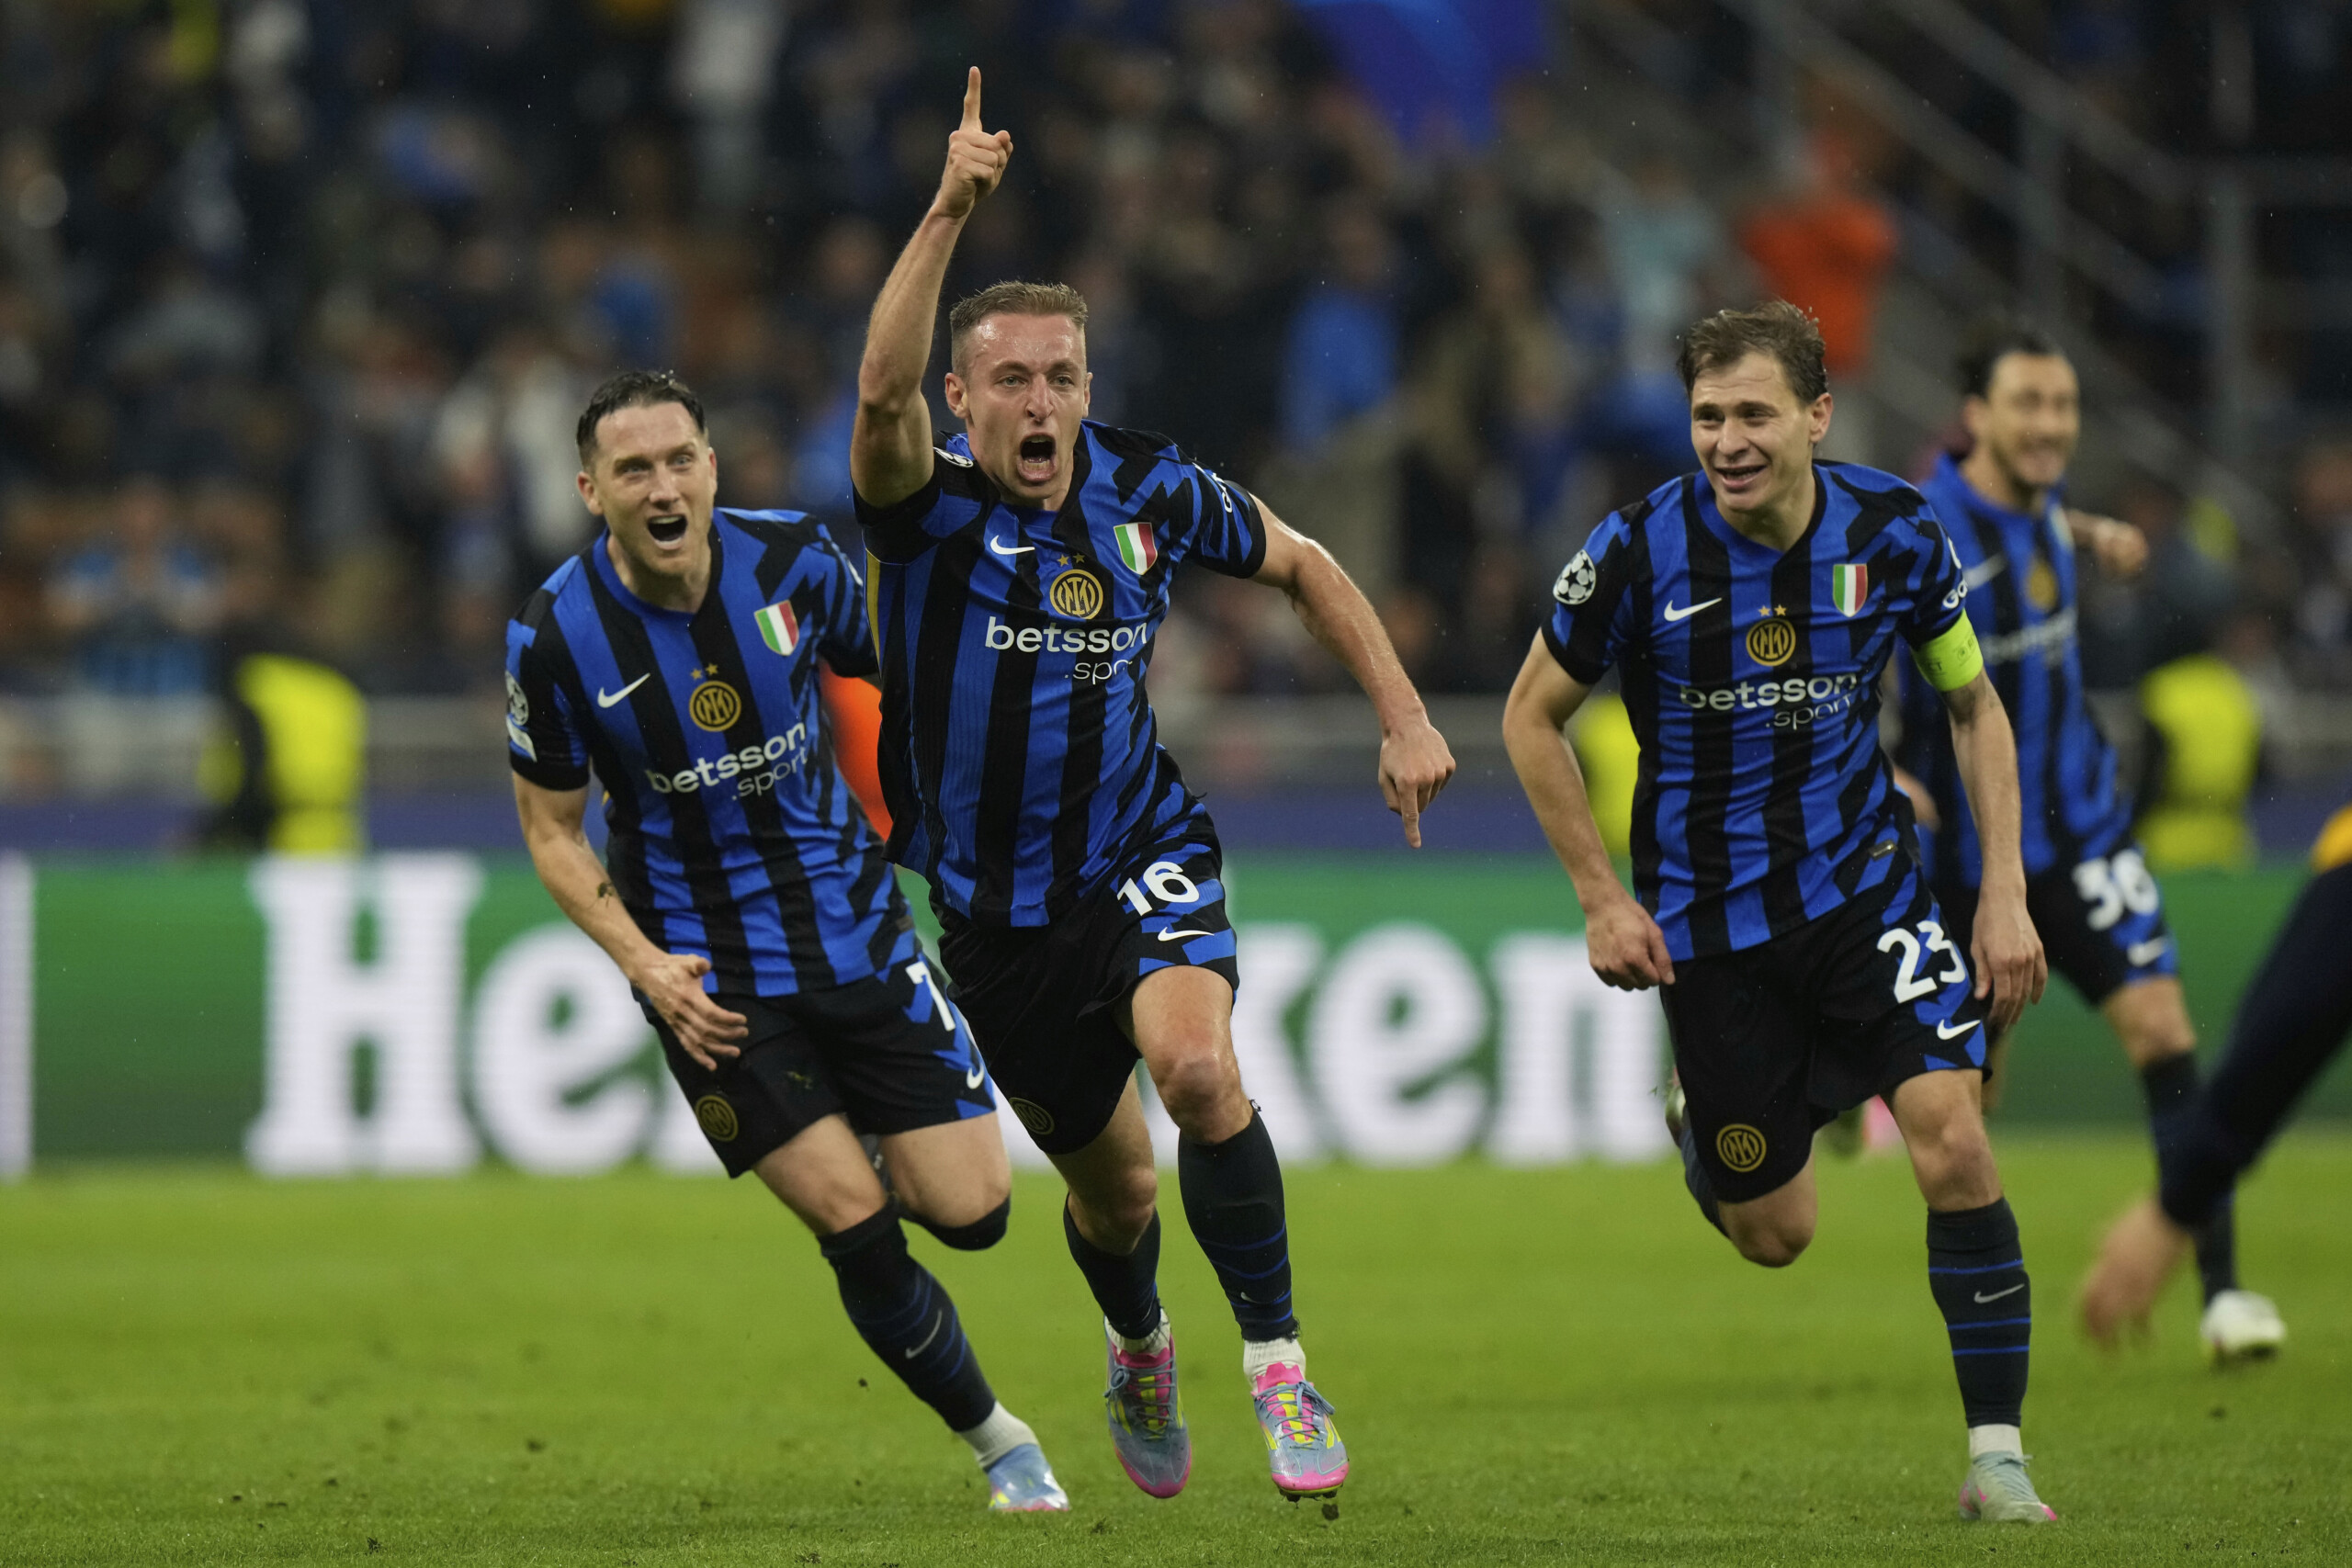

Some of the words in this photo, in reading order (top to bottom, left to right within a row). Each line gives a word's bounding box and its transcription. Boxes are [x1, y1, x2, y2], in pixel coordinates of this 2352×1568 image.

[985, 615, 1148, 653] betsson
[1680, 673, 1857, 710] betsson
[645, 722, 806, 793] betsson
[1116, 861, 1200, 916] 16
[1876, 919, 1966, 1004] 23
[905, 961, 956, 1032] 7
